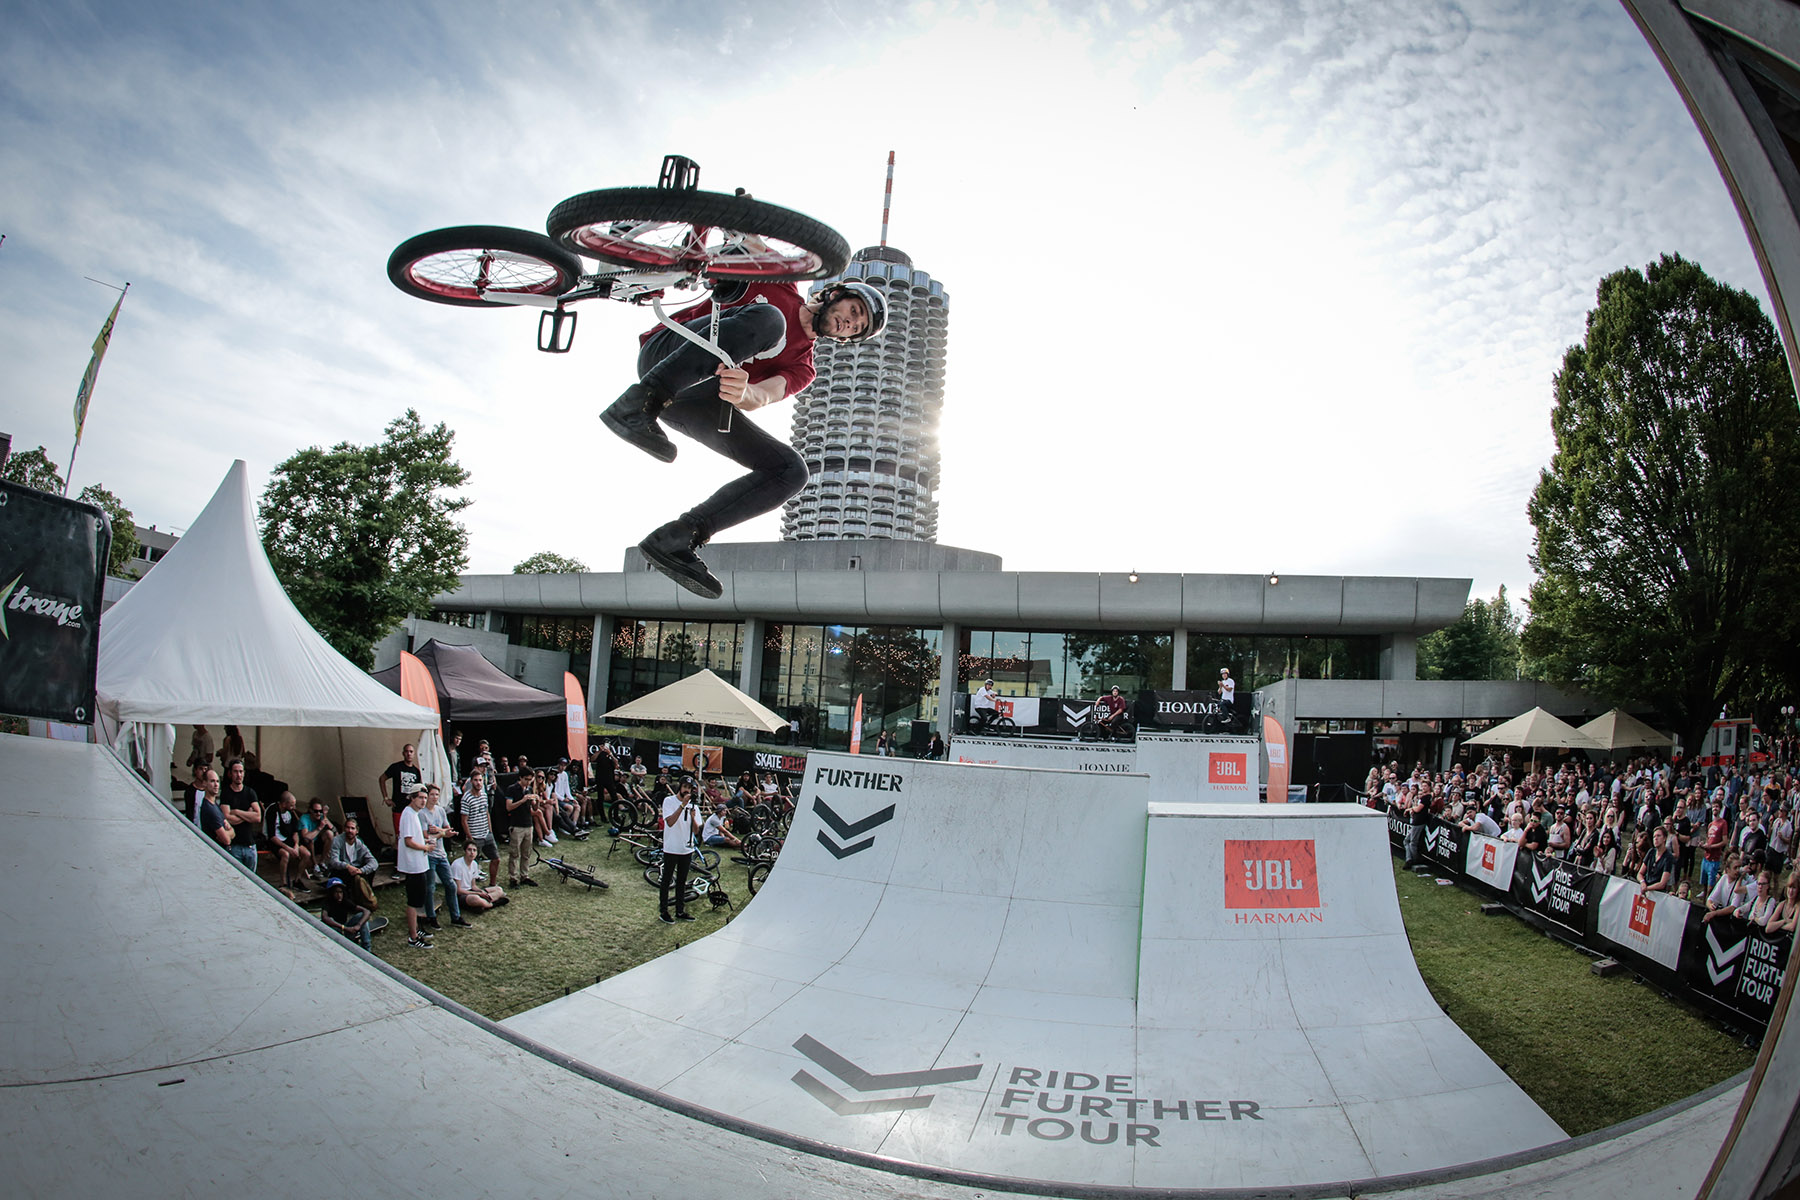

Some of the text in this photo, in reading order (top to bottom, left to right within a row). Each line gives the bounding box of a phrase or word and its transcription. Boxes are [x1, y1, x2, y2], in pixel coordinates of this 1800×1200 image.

[815, 767, 903, 793] FURTHER
[1079, 763, 1130, 773] HOMME
[1216, 761, 1240, 776] JBL
[1243, 860, 1303, 891] JBL
[1555, 869, 1573, 886] RIDE
[1551, 896, 1570, 915] TOUR
[1553, 883, 1586, 906] FURTHER
[1235, 912, 1323, 924] HARMAN
[1634, 905, 1649, 926] JBL
[1750, 938, 1779, 964] RIDE
[1741, 976, 1774, 1005] TOUR
[1008, 1066, 1133, 1094] RIDE
[1000, 1088, 1265, 1121] FURTHER
[994, 1111, 1162, 1147] TOUR
